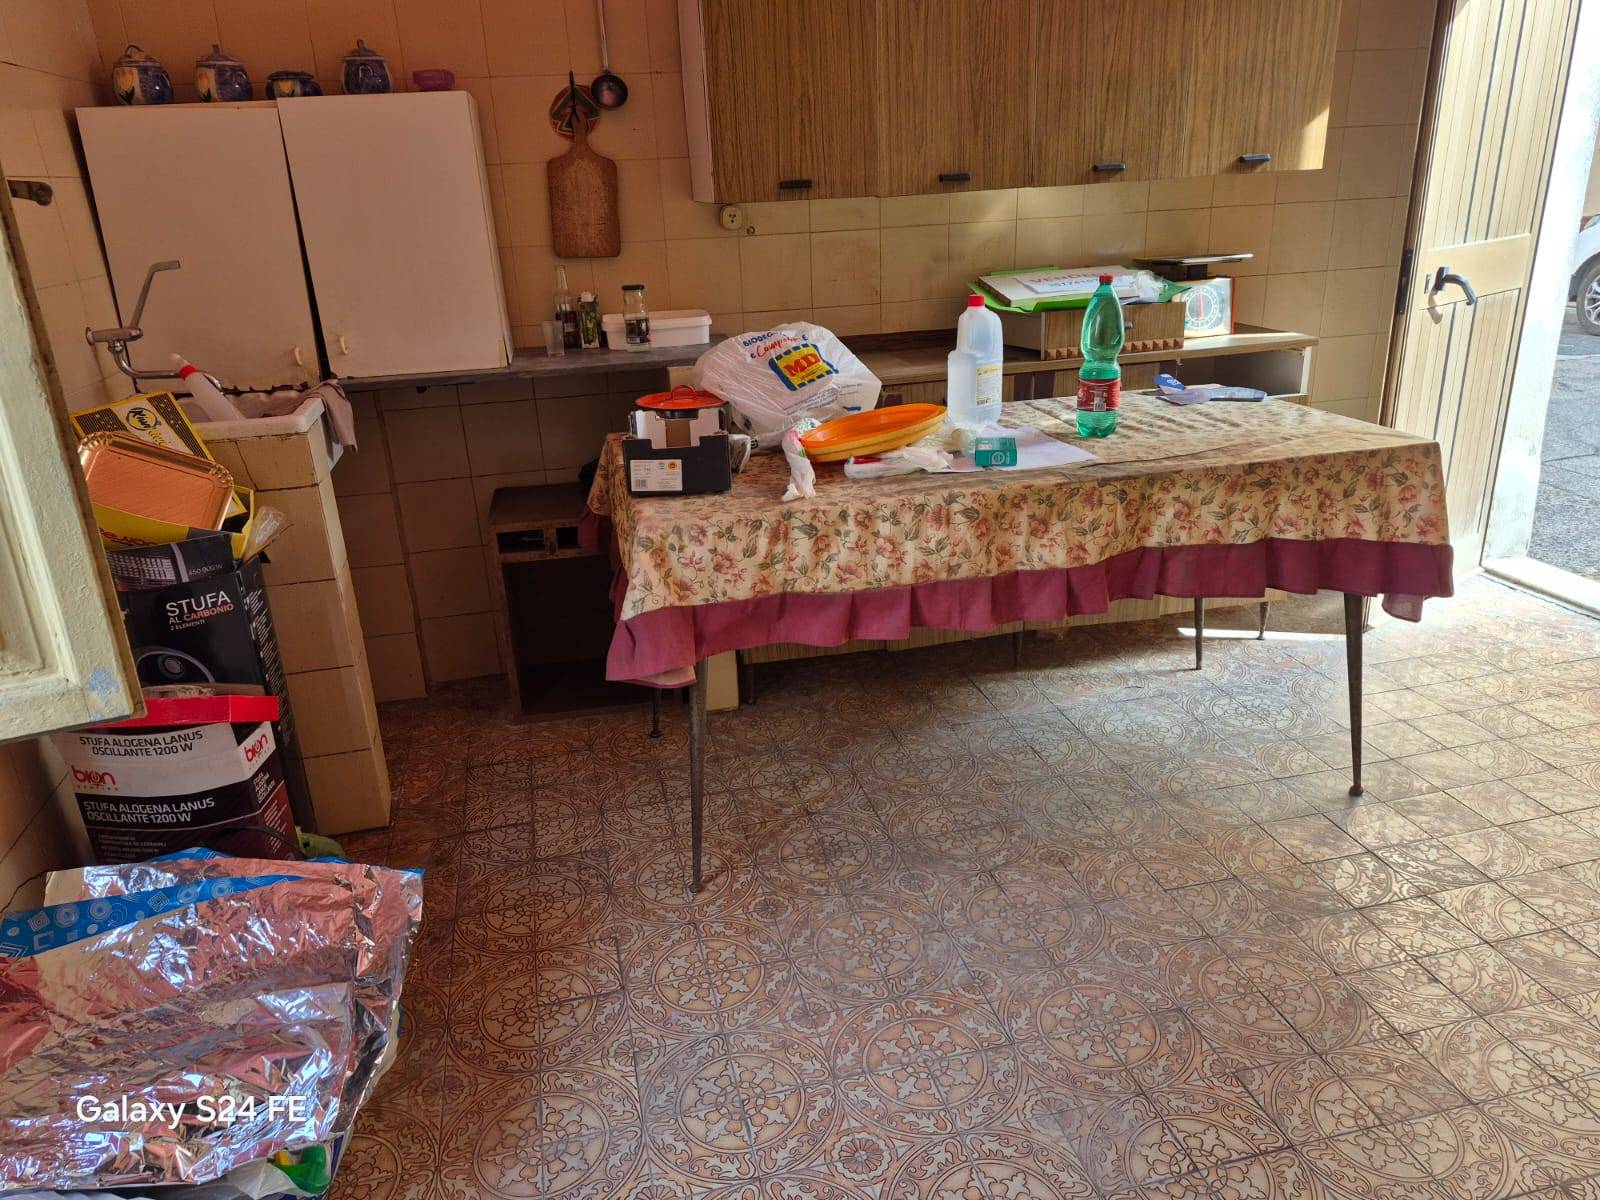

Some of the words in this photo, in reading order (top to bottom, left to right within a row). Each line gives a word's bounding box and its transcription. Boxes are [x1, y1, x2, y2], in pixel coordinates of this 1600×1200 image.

[784, 354, 820, 377] MD
[166, 590, 231, 616] STUFA
[169, 617, 182, 625] AL
[183, 603, 234, 621] CARBONIO
[80, 736, 111, 747] STUFA
[112, 736, 161, 748] ALOGENA
[163, 730, 204, 745] LANUS
[92, 746, 152, 757] OSCILLANTE
[153, 745, 178, 756] 1200
[179, 742, 193, 752] W
[83, 801, 117, 813] STUFA
[118, 801, 170, 814] ALOGENA
[172, 797, 215, 812] LANUS
[86, 811, 148, 824] OSCILLANTE
[149, 812, 177, 824] 1200
[179, 812, 192, 822] W
